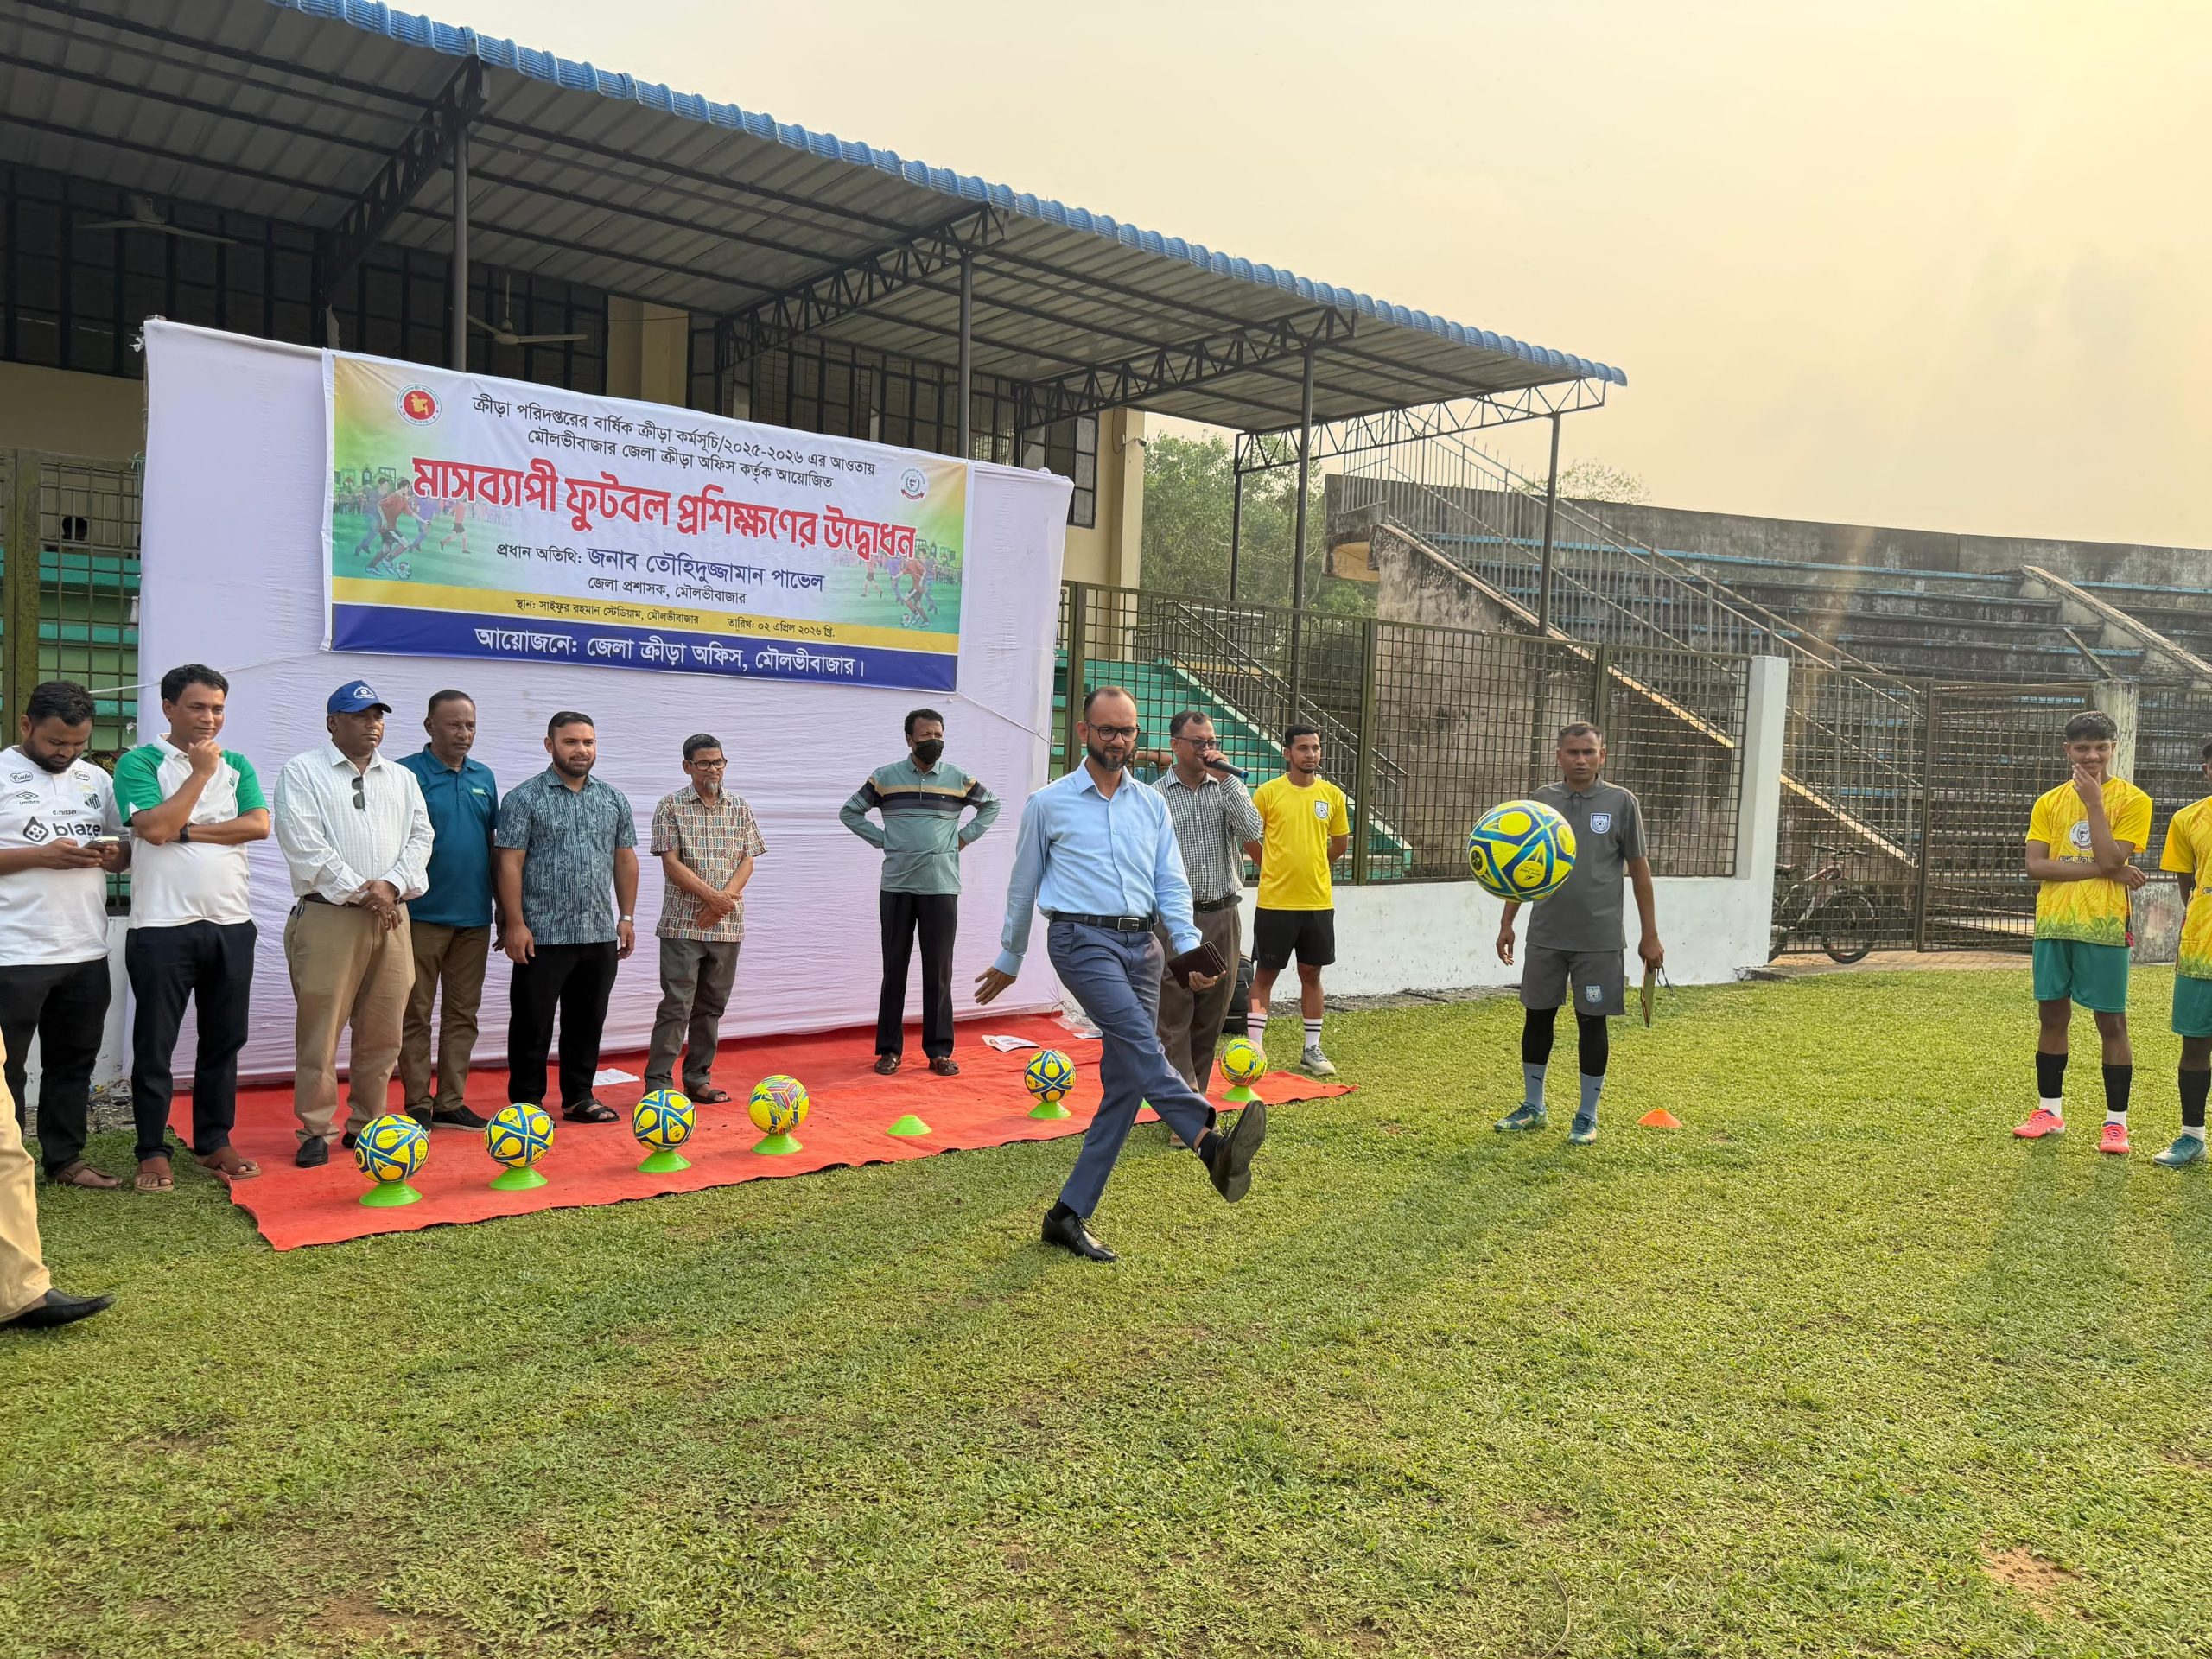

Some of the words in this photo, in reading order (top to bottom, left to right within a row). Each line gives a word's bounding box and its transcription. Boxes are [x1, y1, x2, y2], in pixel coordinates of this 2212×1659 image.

[473, 393, 510, 419] ক্রীড়া
[518, 402, 588, 429] পরিদপ্তরের
[594, 414, 632, 435] বার্ষিক
[638, 419, 671, 443] ক্রীড়া
[808, 454, 826, 467] এর
[830, 456, 876, 476] আওতায়
[528, 425, 616, 456] মৌলভীবাজার
[622, 443, 656, 463] জেলা
[661, 445, 693, 469] ক্রীড়া
[698, 454, 735, 474] অফিস
[740, 462, 772, 484] কর্তৃক
[776, 465, 834, 488] আয়োজিত
[412, 457, 558, 512] মাসব্যাপী
[564, 471, 671, 531] ফুটবল
[677, 483, 818, 549] প্রশিক্ষণের
[823, 504, 917, 561] উদ্বোধন
[497, 542, 531, 562] প্রধান
[536, 543, 582, 564] অতিথি:
[587, 547, 639, 571] জনাব
[646, 550, 766, 586] তৌহিদুজ্জামান
[772, 569, 825, 592] পাভেল
[588, 576, 619, 593] জেলা
[623, 580, 670, 600] প্রশাসক,
[675, 582, 747, 605] মৌলভীবাজার
[515, 598, 536, 610] স্থান:
[539, 599, 570, 613] সাইফুর
[573, 604, 600, 616] রহমান
[603, 604, 644, 620] স্টেডিয়াম,
[647, 609, 699, 625] মৌলভীবাজার
[727, 615, 755, 631] তারিখ:
[758, 622, 771, 632] ০২
[773, 620, 796, 633] এপ্রিল
[798, 625, 822, 637] ২০২৬
[474, 626, 578, 654] আয়োজনে:
[587, 635, 634, 660] জেলা
[639, 635, 687, 666] ক্রীড়া
[690, 640, 748, 671] অফিস,
[52, 823, 102, 837] blaze
